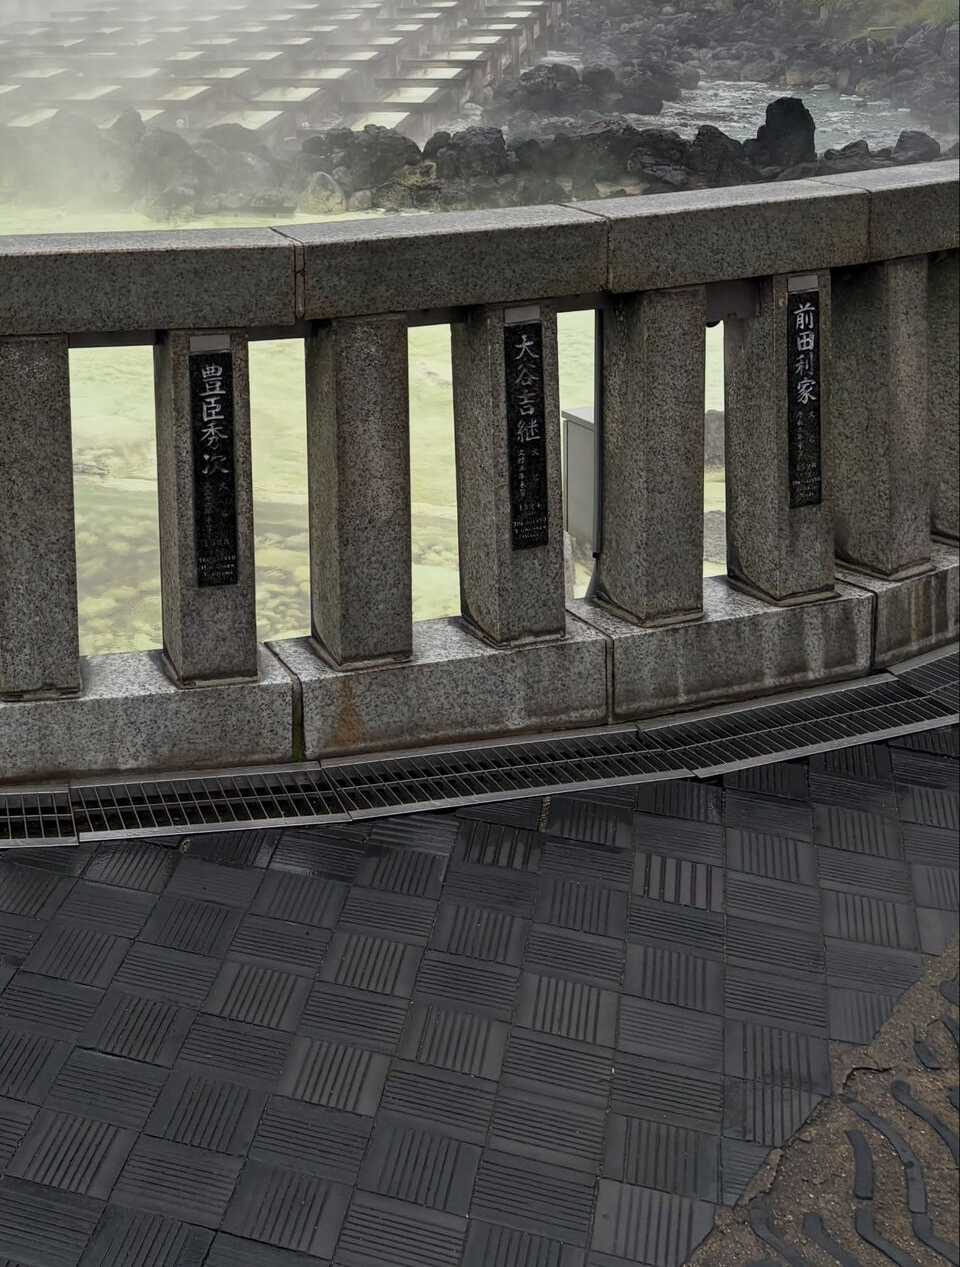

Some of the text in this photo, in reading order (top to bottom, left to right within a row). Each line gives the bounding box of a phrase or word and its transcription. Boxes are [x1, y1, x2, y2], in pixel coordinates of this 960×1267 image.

[514, 334, 540, 443] 大谷吉継
[793, 301, 817, 405] 前田利家
[199, 364, 229, 475] 豊臣秀次
